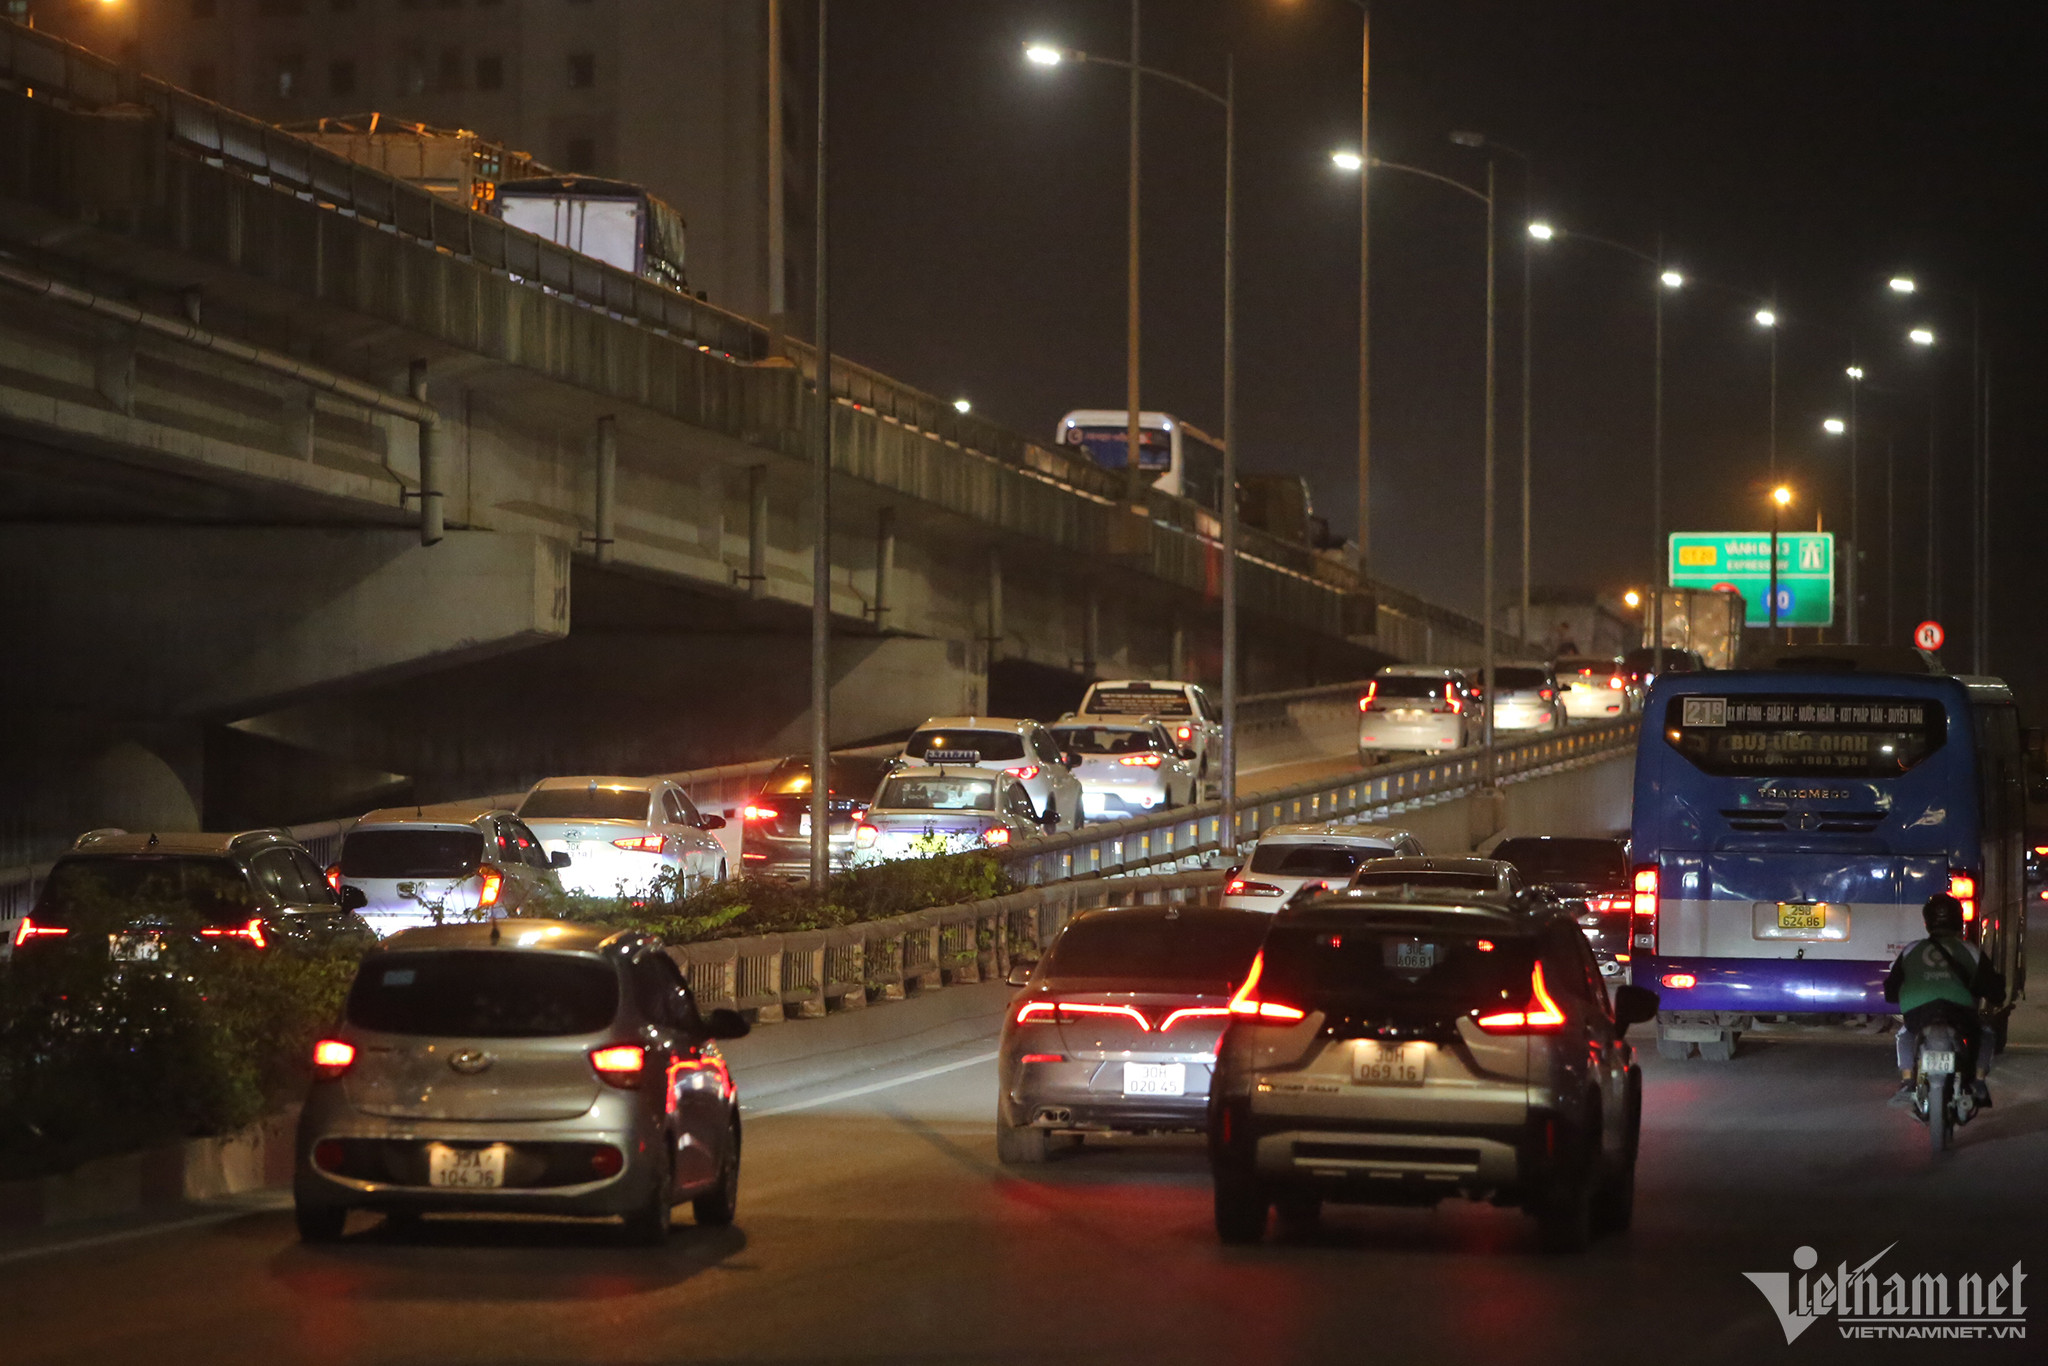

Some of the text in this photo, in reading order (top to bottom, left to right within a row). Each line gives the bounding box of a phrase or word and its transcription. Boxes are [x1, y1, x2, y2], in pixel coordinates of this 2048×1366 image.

[1731, 734, 1767, 751] BUS
[1783, 916, 1820, 927] 624.86
[1375, 1047, 1405, 1063] 30H
